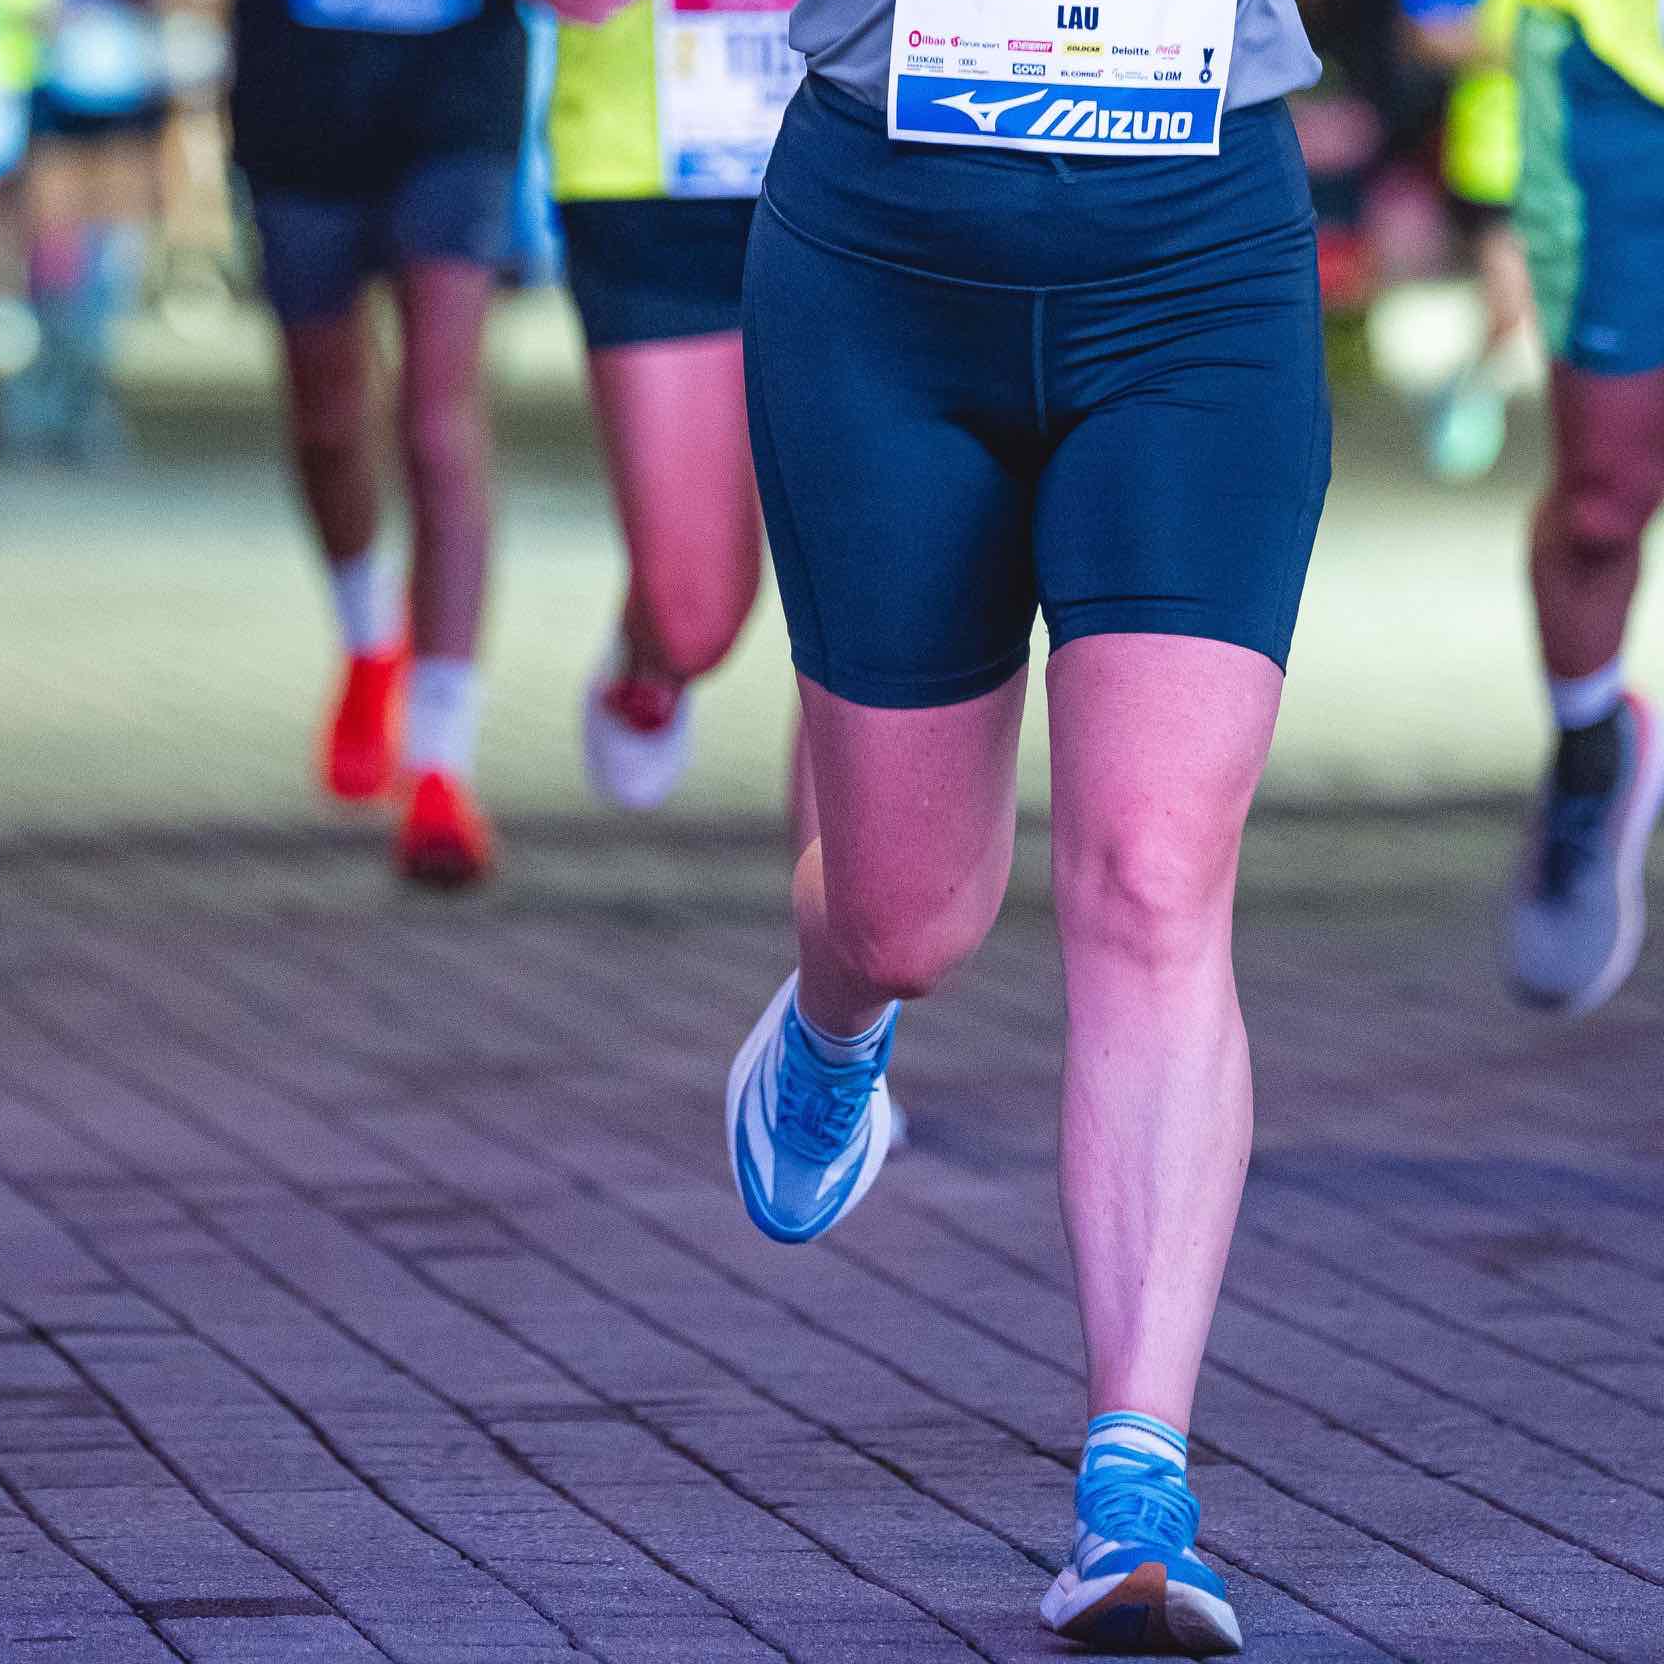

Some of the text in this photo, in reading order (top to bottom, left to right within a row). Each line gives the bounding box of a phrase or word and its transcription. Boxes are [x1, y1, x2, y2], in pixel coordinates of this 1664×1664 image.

[1057, 5, 1100, 31] LAU
[1111, 45, 1150, 56] Deloitte
[1013, 64, 1044, 75] GOYA
[1026, 97, 1193, 141] MIZUNO
